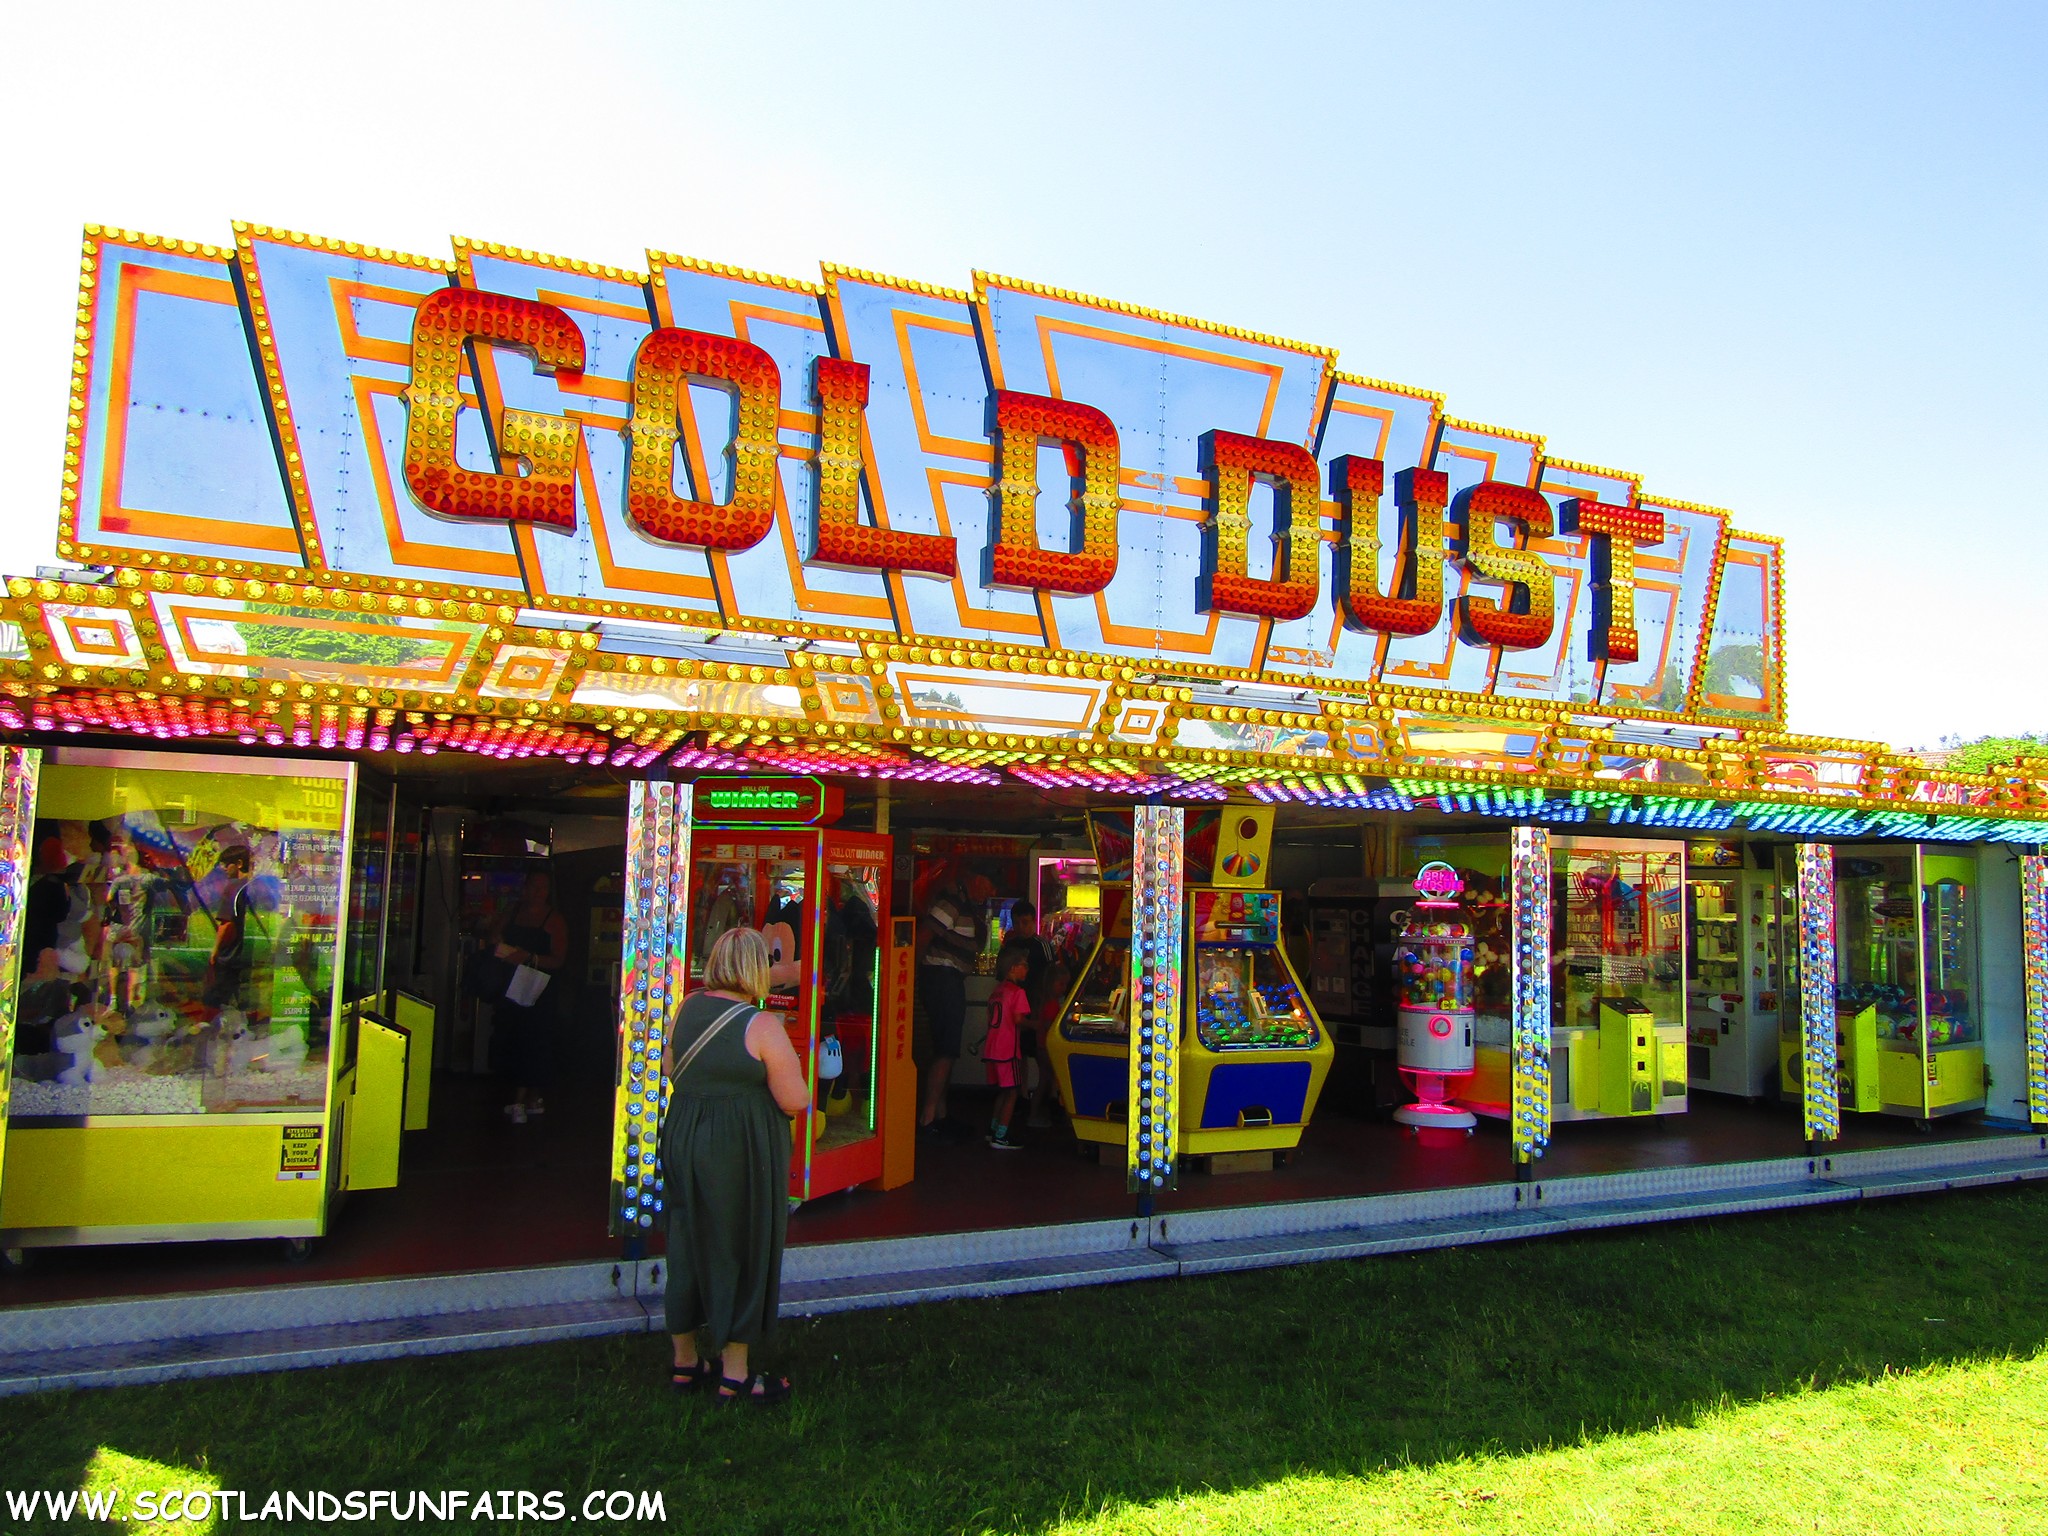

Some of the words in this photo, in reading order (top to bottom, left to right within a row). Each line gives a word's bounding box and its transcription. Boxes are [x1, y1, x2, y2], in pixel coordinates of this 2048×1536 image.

[399, 287, 1122, 598] GOLD
[1195, 429, 1665, 665] DUST
[710, 791, 799, 809] WINNER
[856, 849, 884, 860] WINNER
[1412, 879, 1464, 892] CAPSULE
[1351, 909, 1372, 1016] CHANGE
[896, 951, 908, 1060] CHANGE
